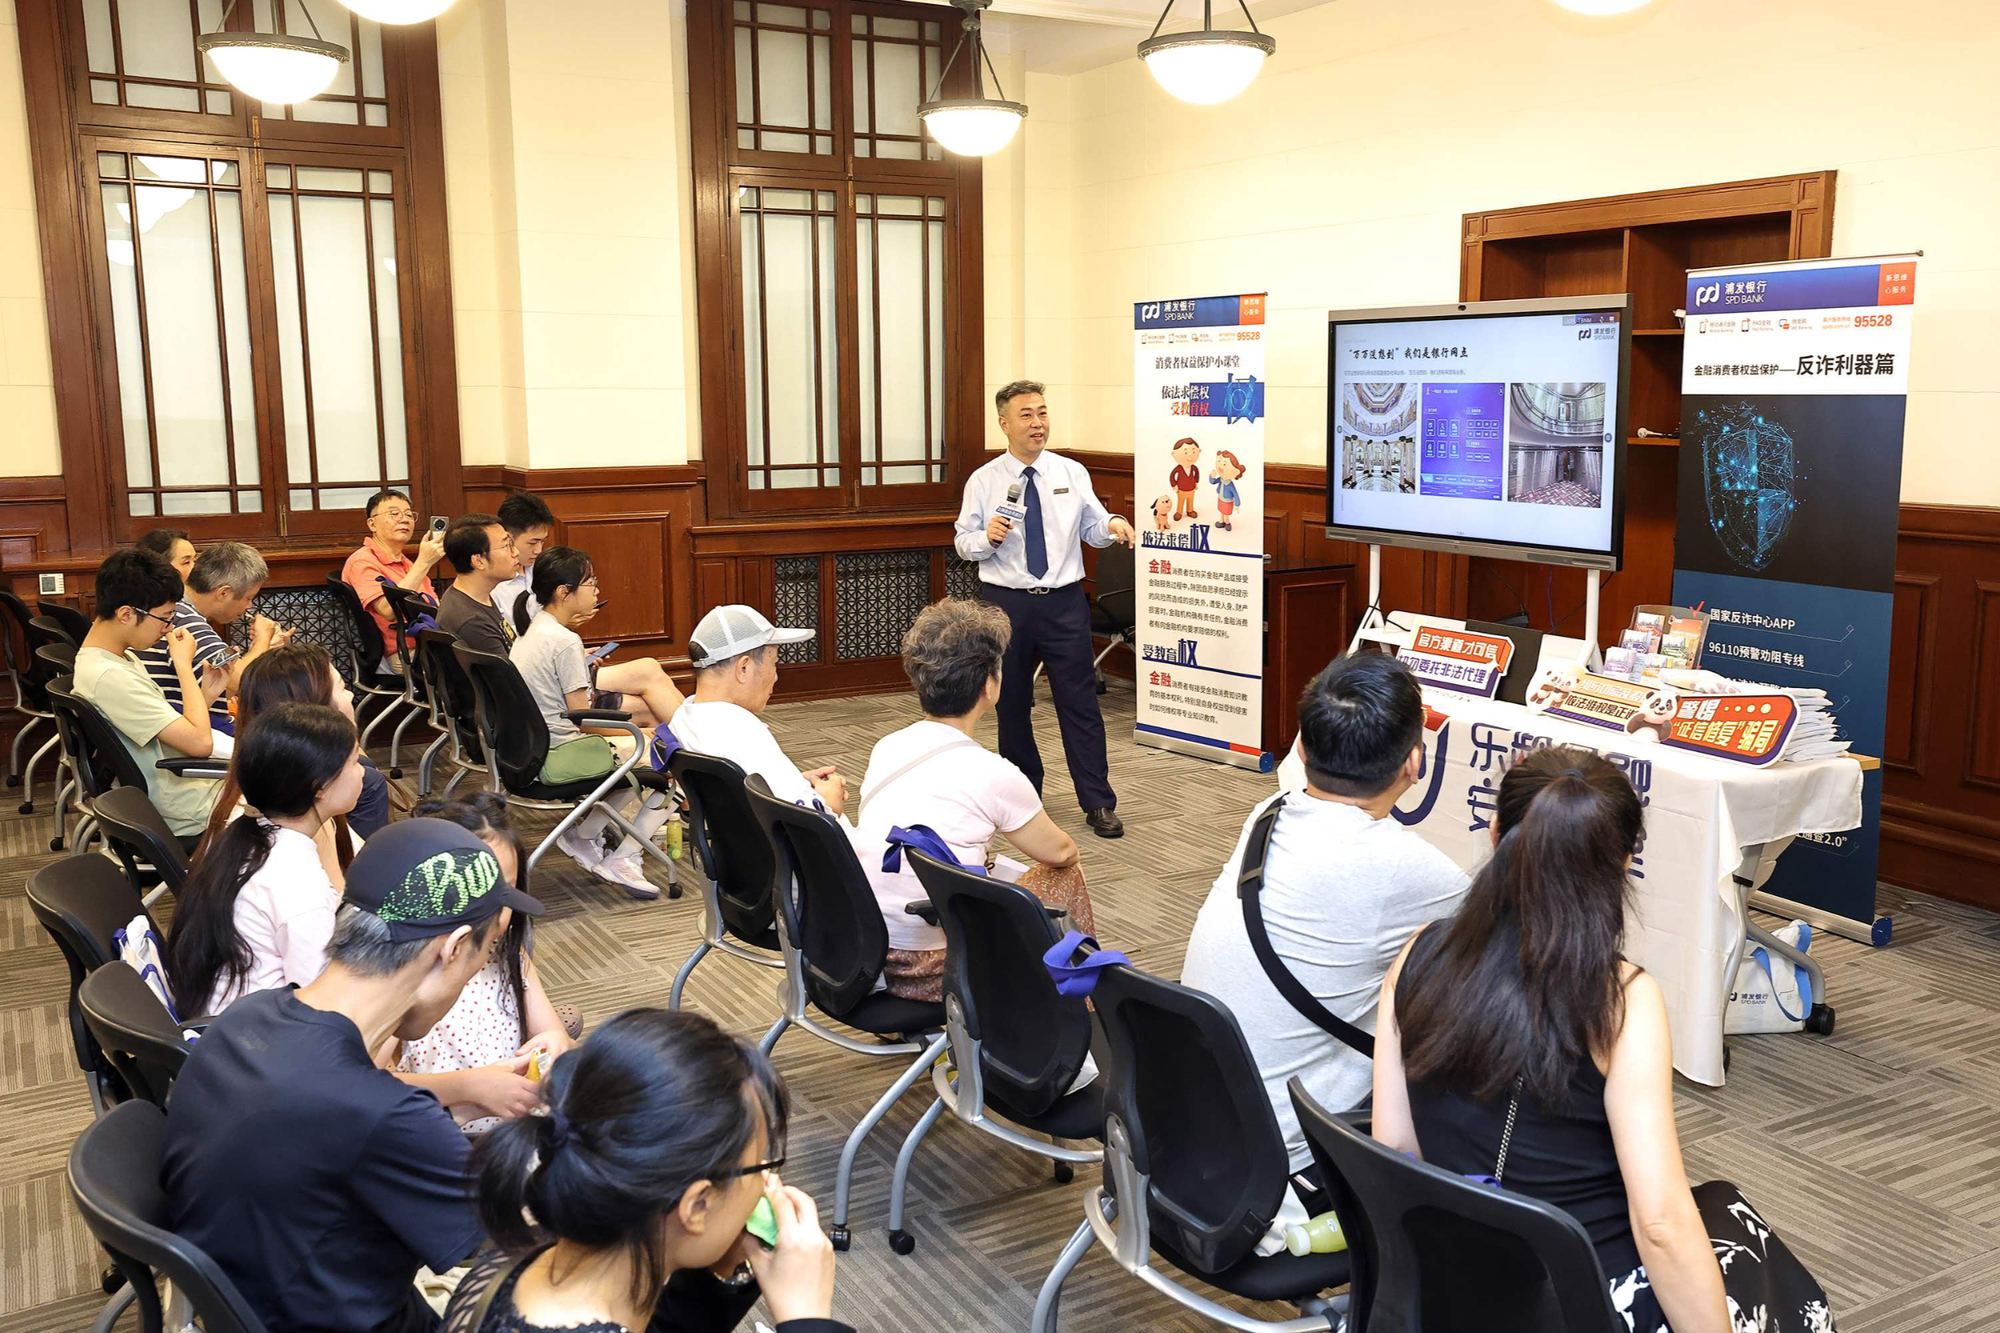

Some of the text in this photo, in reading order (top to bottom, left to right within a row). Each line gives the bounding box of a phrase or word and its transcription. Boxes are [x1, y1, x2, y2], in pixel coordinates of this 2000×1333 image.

[1885, 273, 1908, 282] 新思维
[1725, 280, 1767, 295] 浦发银行
[1885, 285, 1907, 294] 心服务
[1163, 300, 1196, 312] 浦发银行
[1725, 293, 1765, 305] SPD BANK
[1164, 311, 1195, 321] SPD BANK
[1854, 314, 1893, 328] 95528
[1236, 331, 1261, 341] 95528
[1404, 346, 1469, 360] 我们是银行网点
[1155, 355, 1240, 370] 消费者权益保护小课堂
[1161, 385, 1210, 400] 依法求偿权
[1170, 401, 1210, 416] 受教育权
[1142, 523, 1211, 550] 依法求偿权
[1710, 608, 1796, 630] 国家反诈中心APP
[1142, 638, 1198, 667] 受教育权
[1418, 632, 1500, 659] 官方渠道才可信
[1708, 641, 1805, 668] 96110预警劝阻专线
[1676, 698, 1722, 721] 警惕
